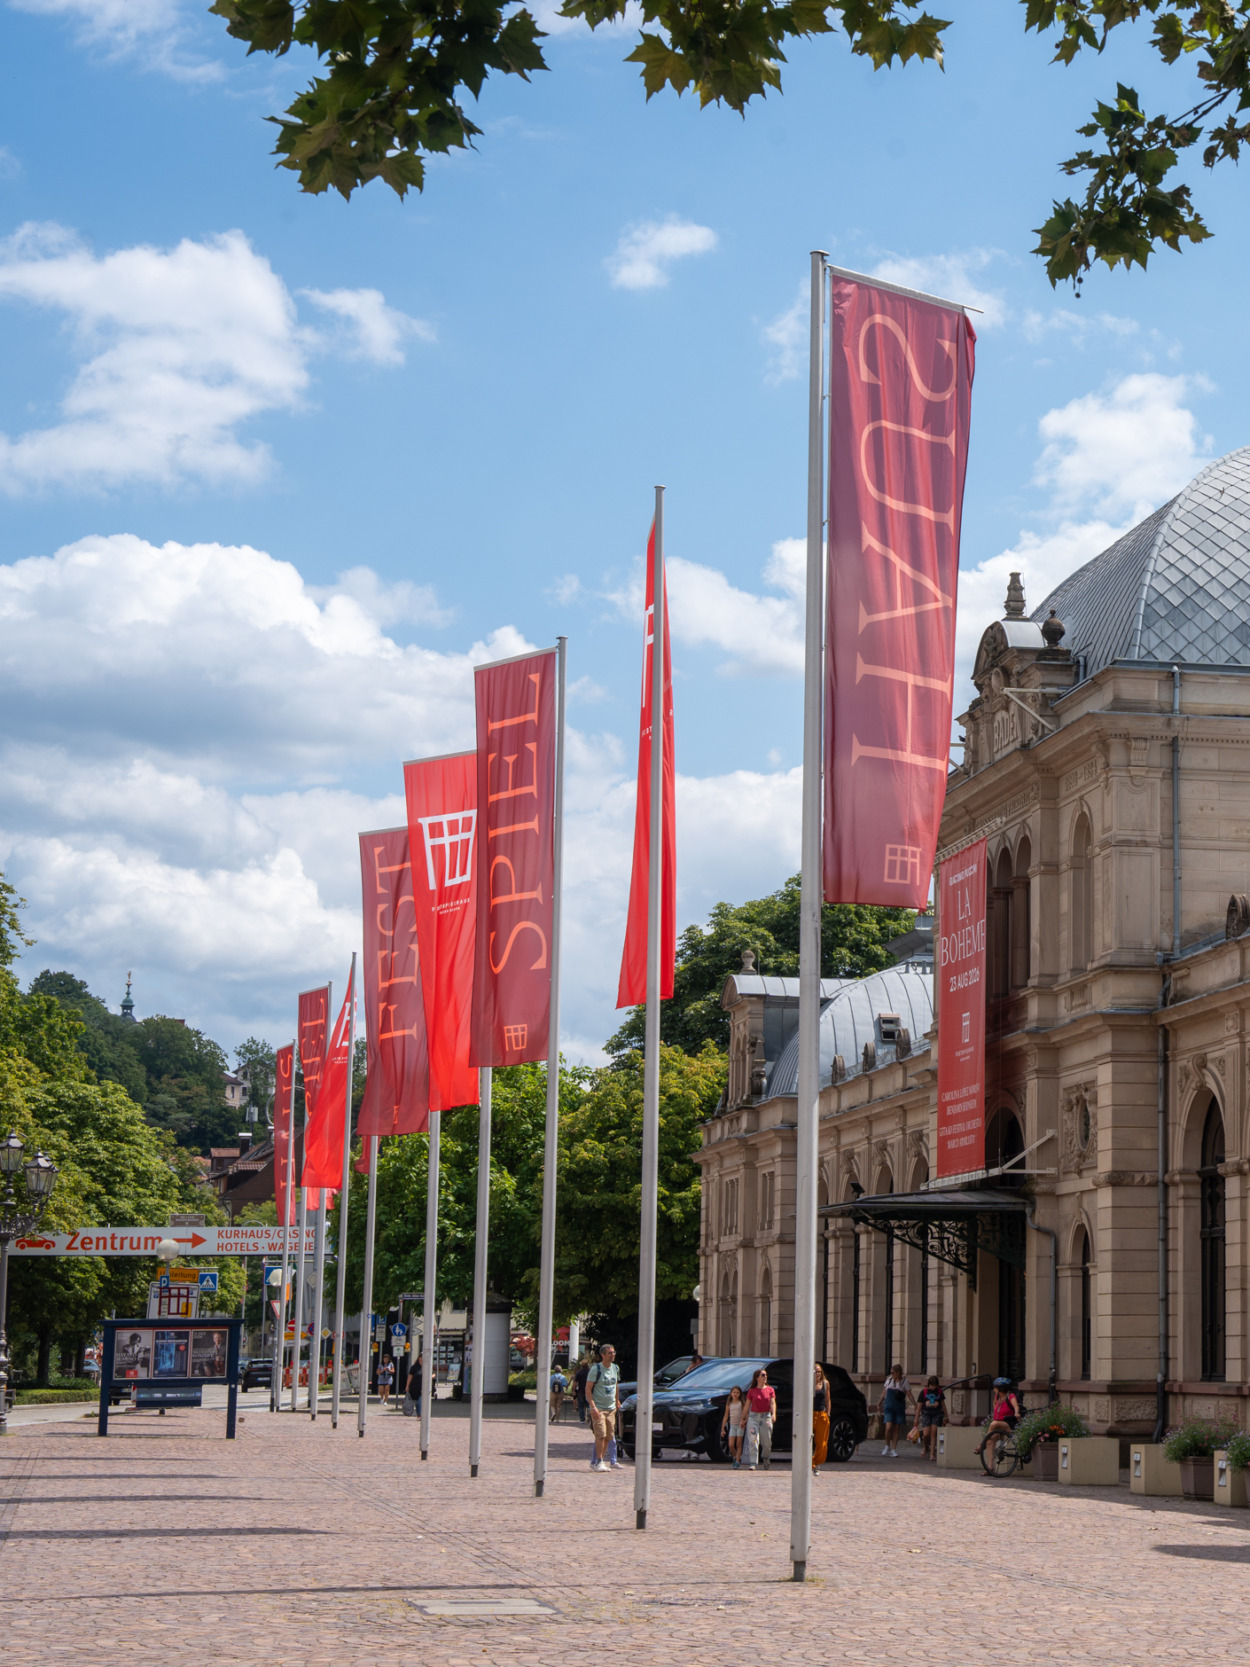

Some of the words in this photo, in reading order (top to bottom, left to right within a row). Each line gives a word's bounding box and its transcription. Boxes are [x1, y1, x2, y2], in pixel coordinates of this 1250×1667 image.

[487, 672, 548, 975] SPIEL
[431, 897, 471, 913] FSTSPIELHAUS
[957, 886, 972, 921] LA
[373, 846, 419, 1045] FEST
[941, 919, 985, 966] BOHÈME
[949, 975, 957, 993] 23
[957, 971, 968, 990] AUG
[968, 966, 981, 986] 2026
[65, 1232, 163, 1251] Zentrum
[217, 1242, 259, 1252] HOTELS
[159, 1270, 196, 1280] Uleitung
